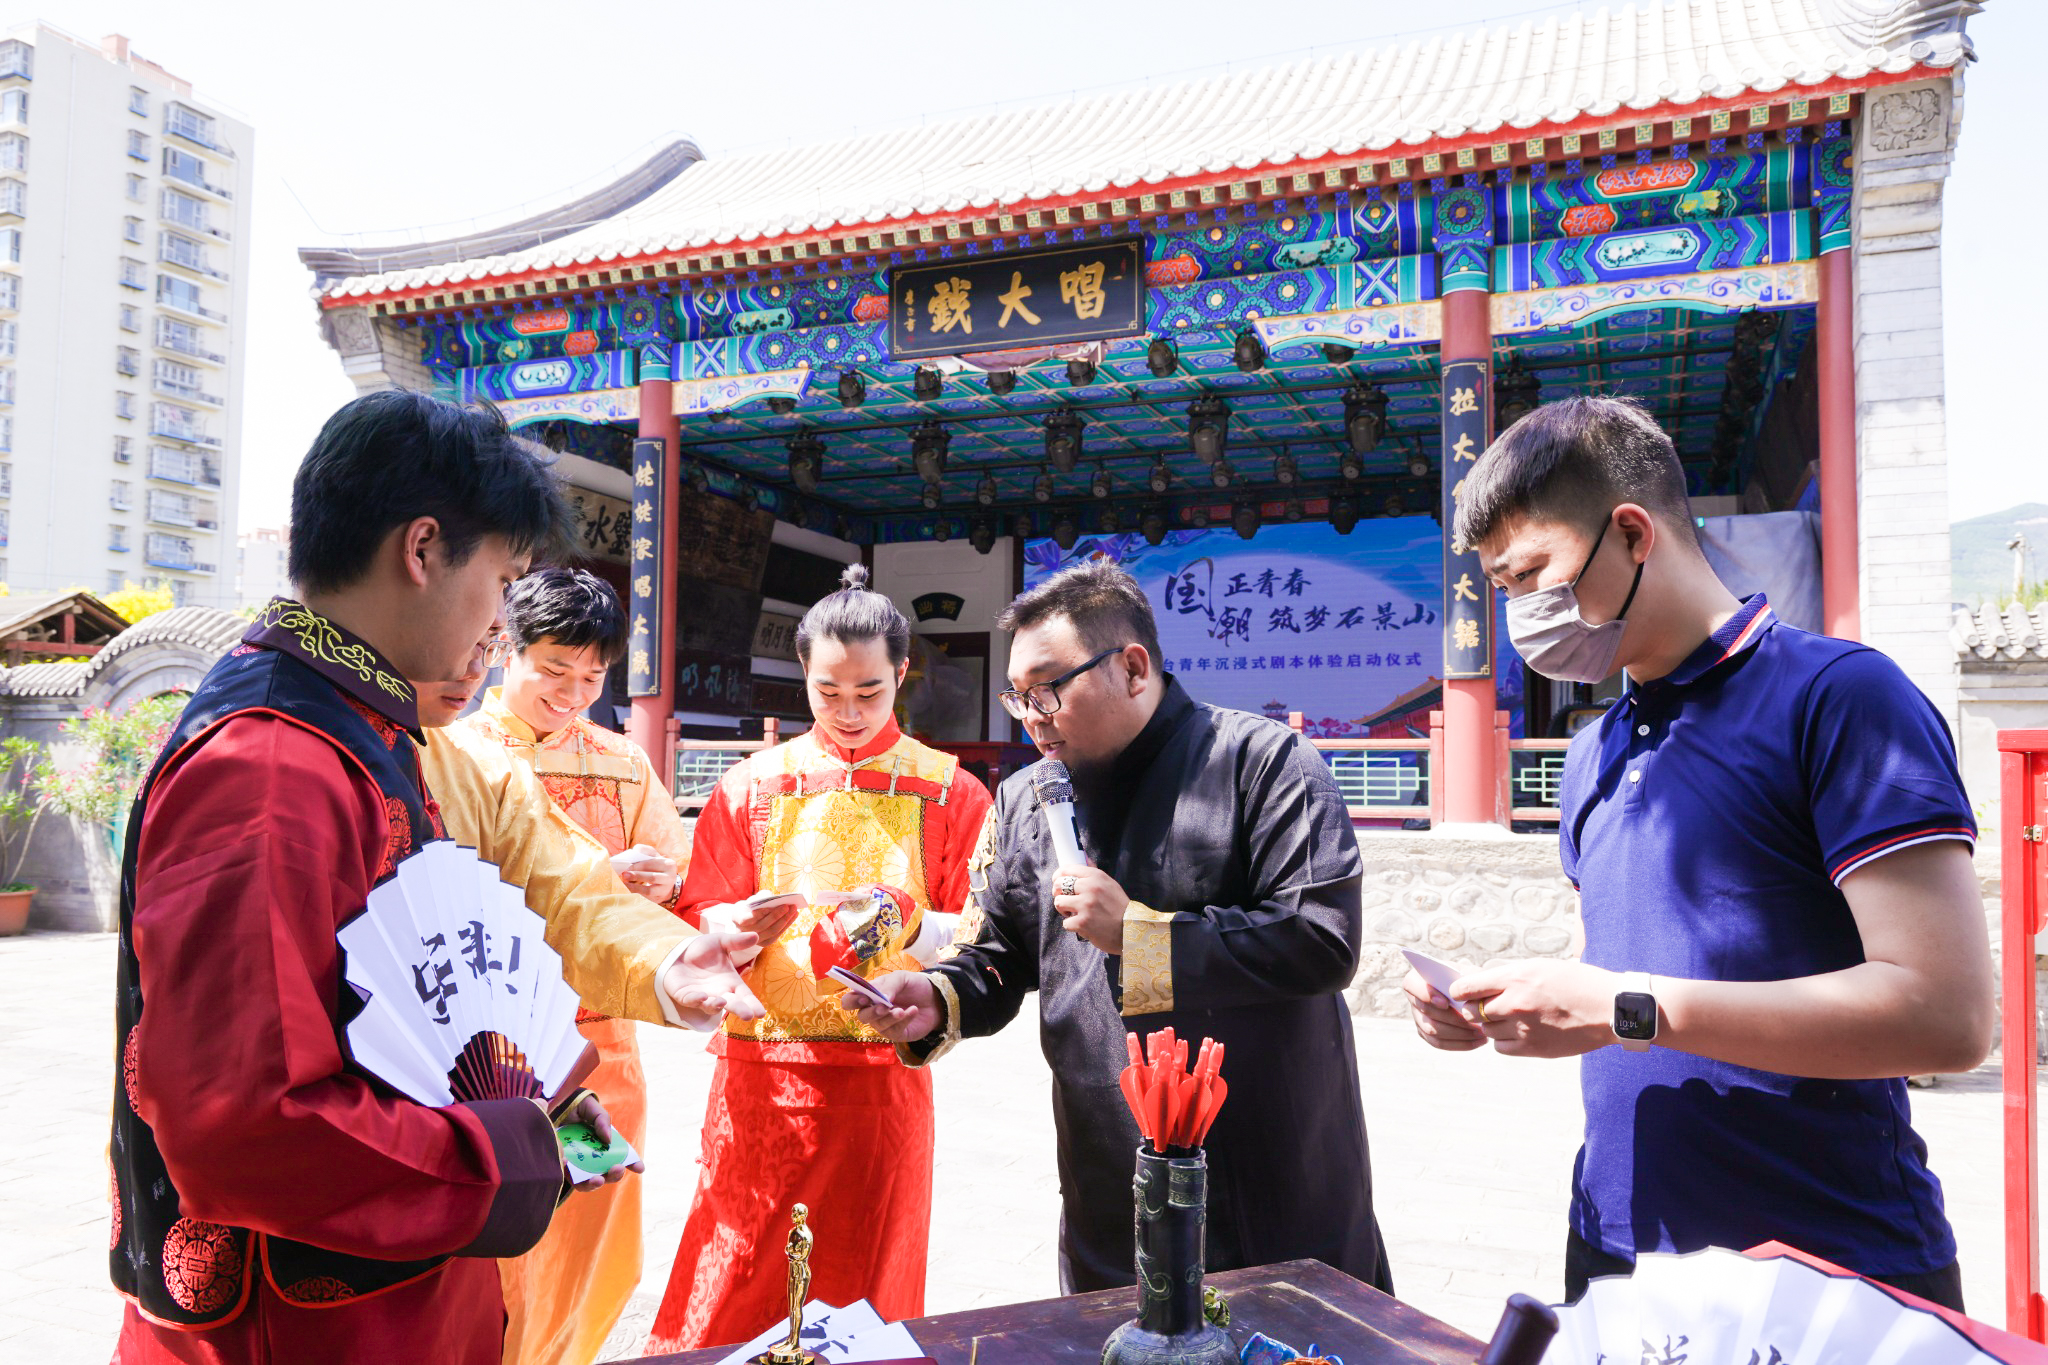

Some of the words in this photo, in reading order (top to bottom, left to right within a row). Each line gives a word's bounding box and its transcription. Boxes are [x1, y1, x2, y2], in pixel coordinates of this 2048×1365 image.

[1224, 567, 1312, 599] 正青春
[1267, 601, 1436, 634] 筑梦石景山
